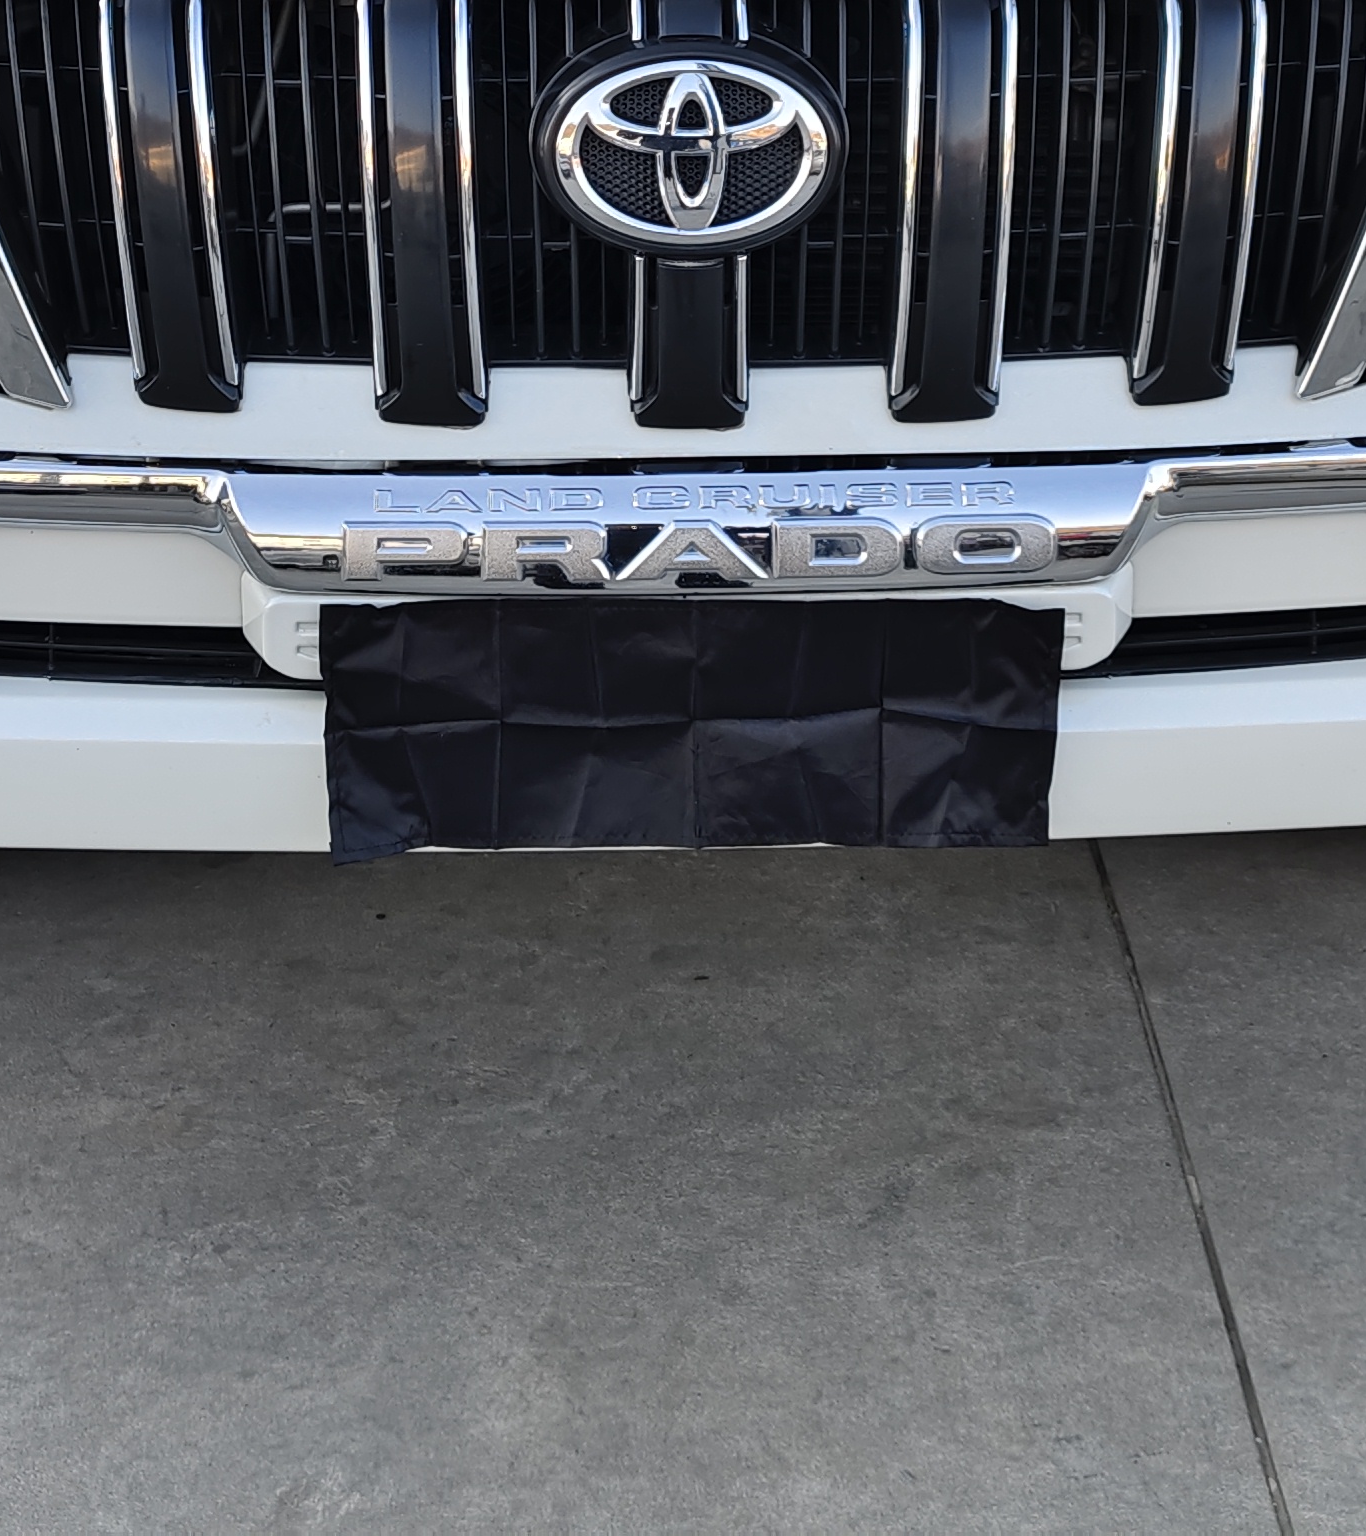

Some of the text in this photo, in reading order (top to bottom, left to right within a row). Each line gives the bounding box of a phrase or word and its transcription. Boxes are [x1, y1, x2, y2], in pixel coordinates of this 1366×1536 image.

[373, 480, 1017, 514] LAND CRUISER
[340, 512, 1060, 582] PRADO
